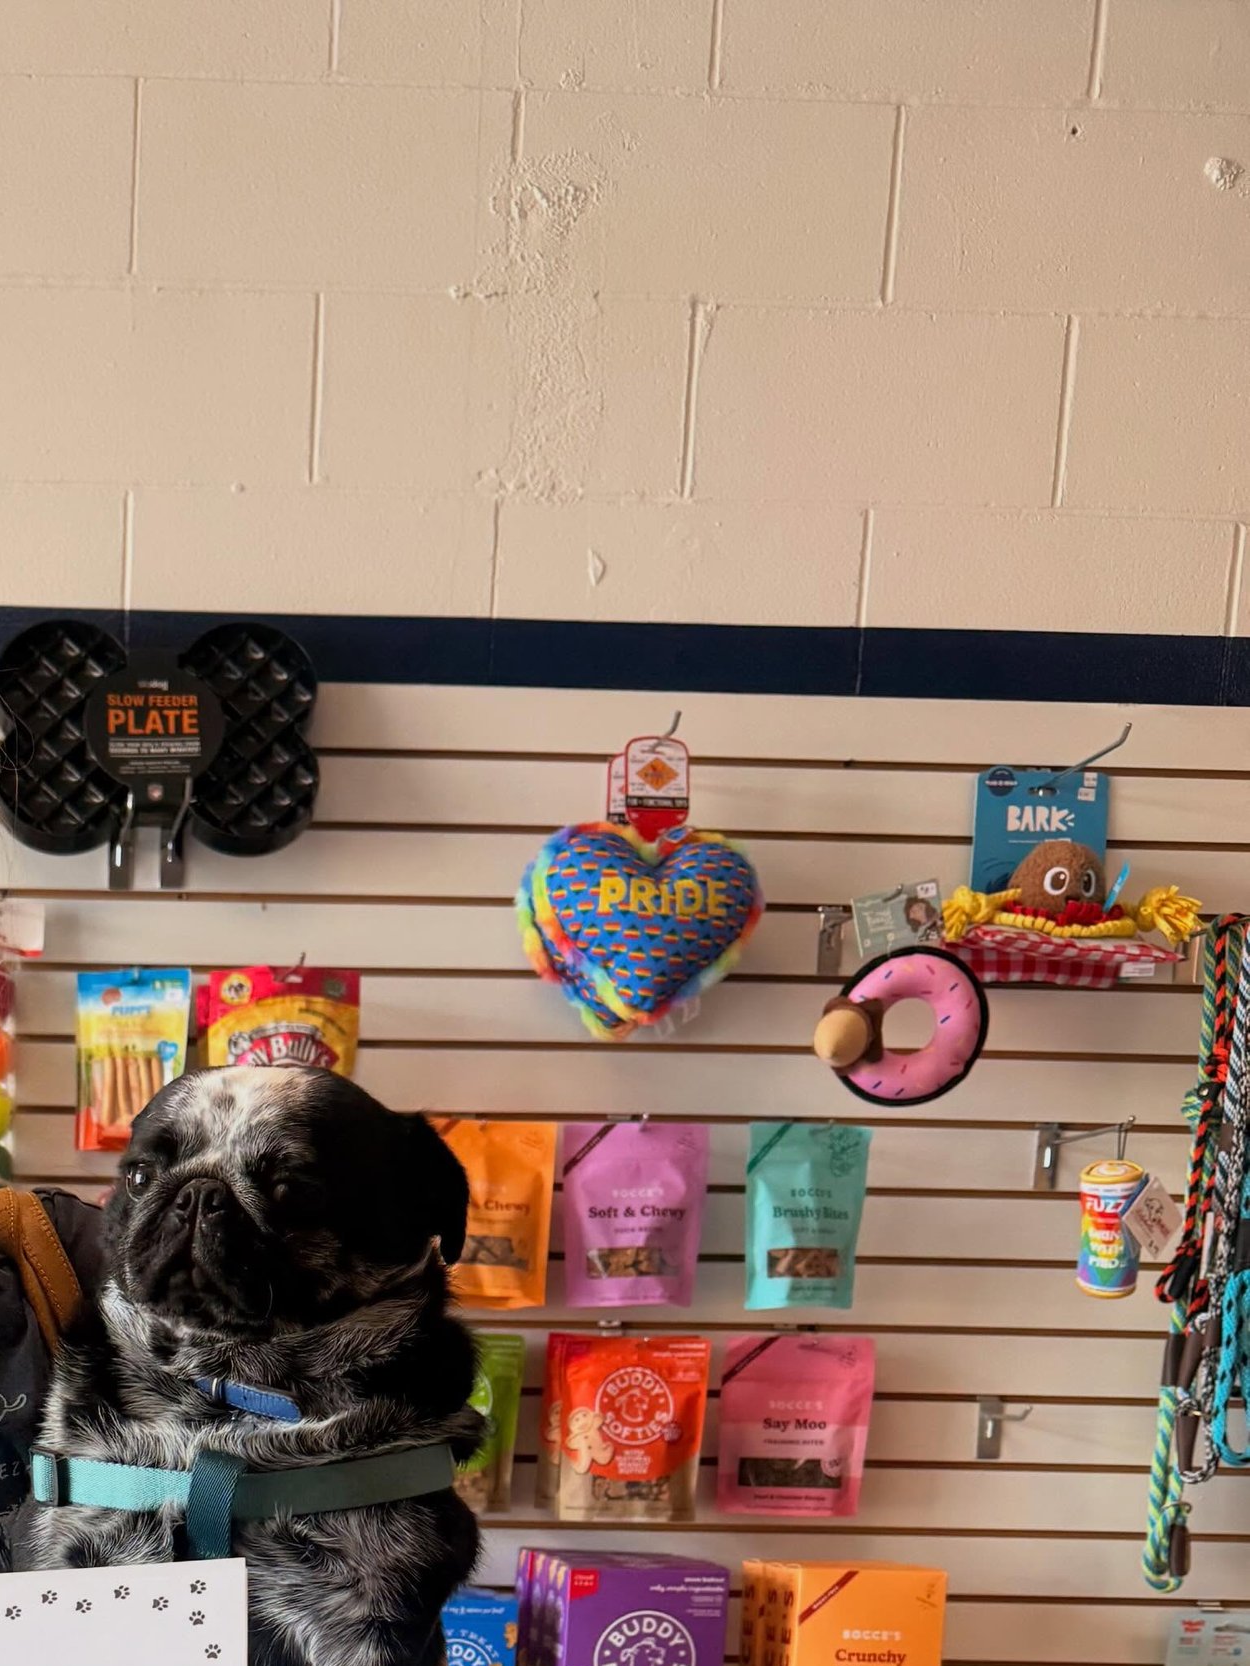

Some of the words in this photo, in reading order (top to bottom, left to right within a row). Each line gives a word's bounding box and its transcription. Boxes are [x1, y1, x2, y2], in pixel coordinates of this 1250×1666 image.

[107, 694, 144, 706] SLOW
[149, 695, 198, 707] FEEDER
[108, 709, 199, 735] PLATE
[1006, 805, 1070, 832] BARK
[597, 877, 728, 917] PRIDE
[483, 1197, 531, 1216] Chewy
[588, 1205, 619, 1219] Soft
[623, 1206, 636, 1218] &
[640, 1204, 686, 1221] Chewy
[773, 1205, 821, 1221] Brushy
[823, 1206, 849, 1219] Bites
[607, 1372, 666, 1397] BUDDY
[602, 1410, 667, 1439] SOFTIES
[763, 1418, 790, 1432] Say
[795, 1418, 827, 1430] Moo
[608, 1617, 685, 1648] BUDDY
[842, 1629, 901, 1641] BOCCE'S
[447, 1644, 485, 1666] DDY
[460, 1629, 500, 1659] TREAT
[835, 1649, 906, 1666] Crunchy
